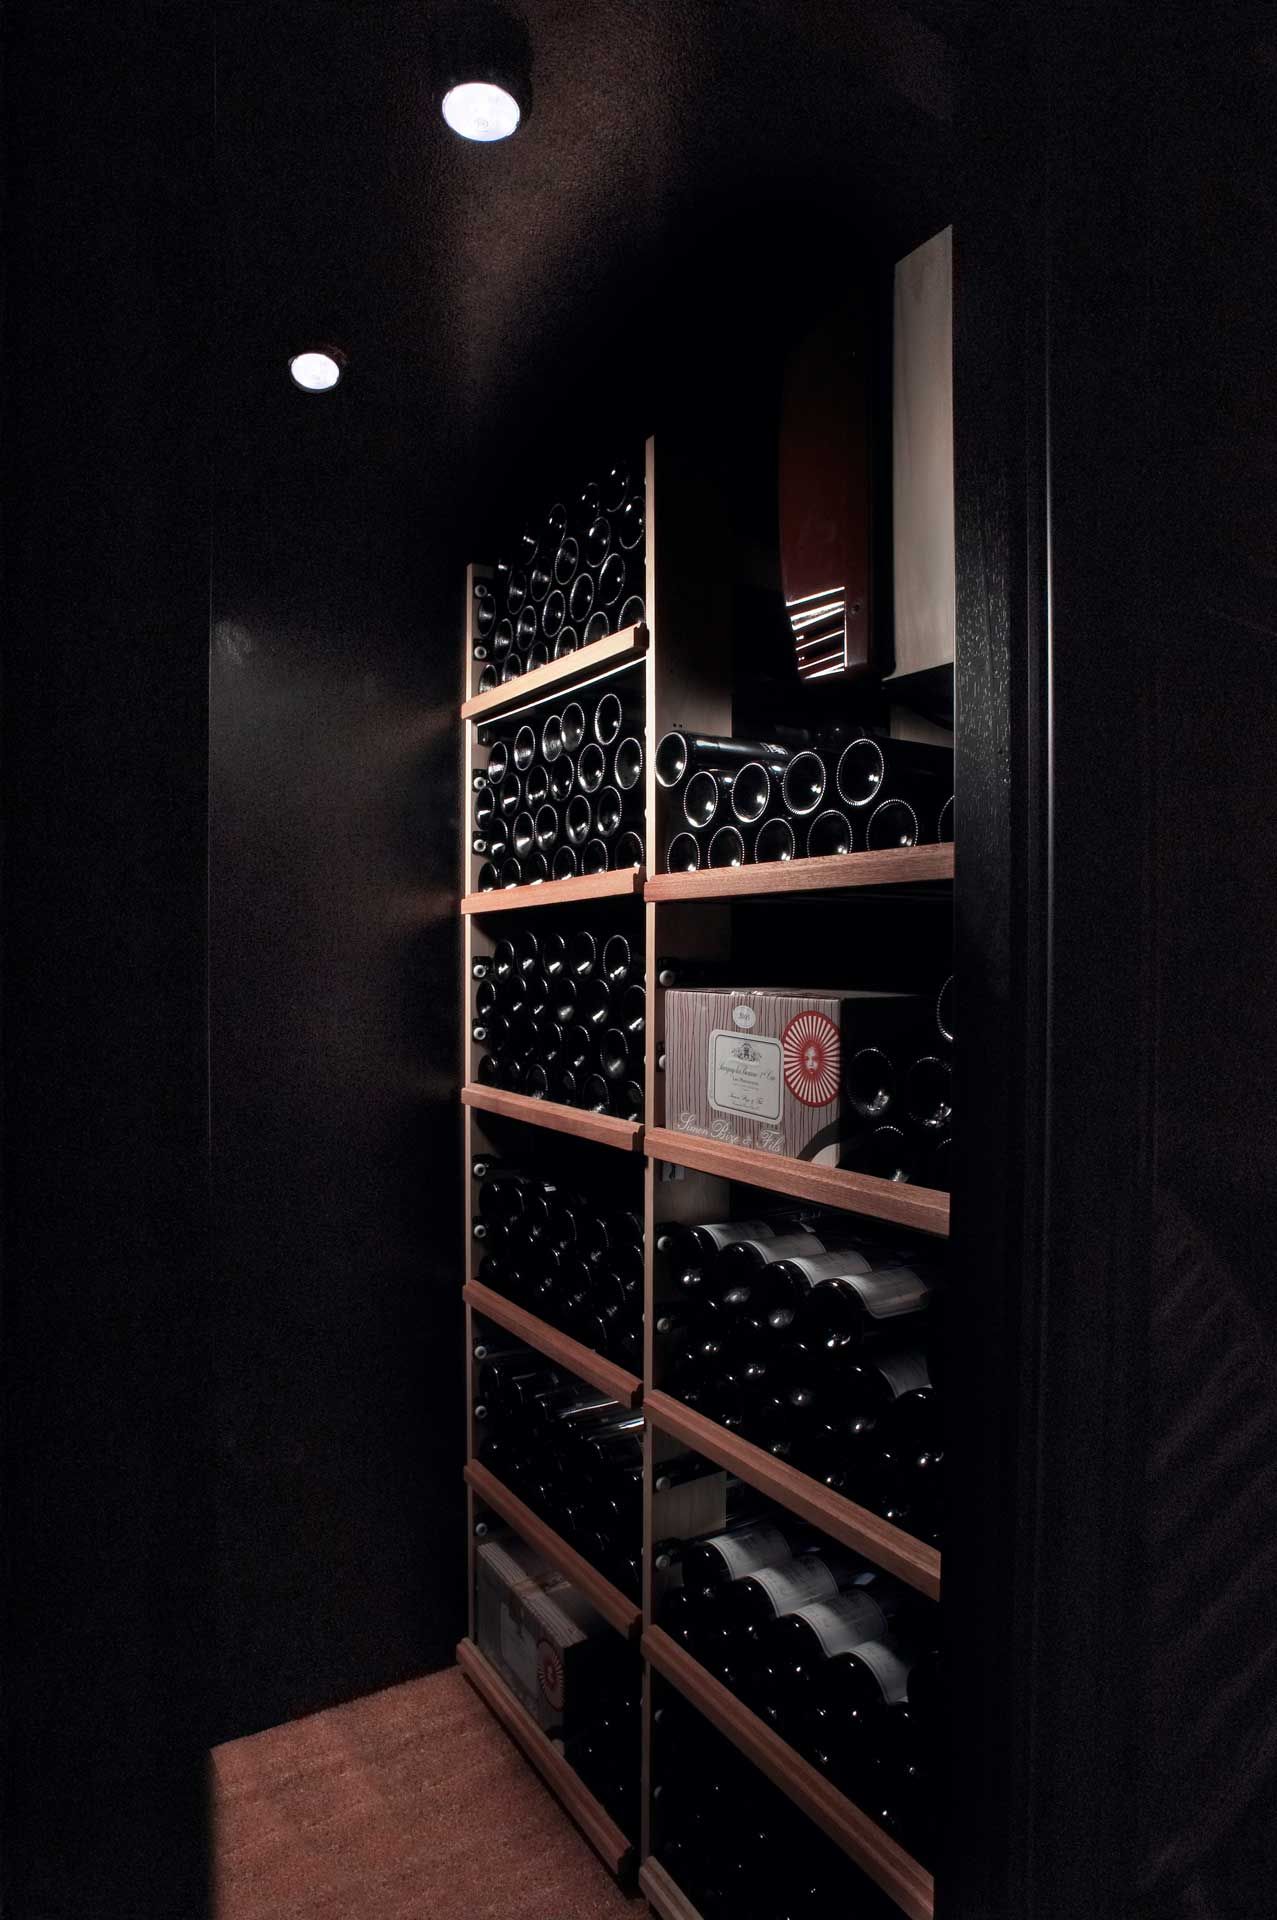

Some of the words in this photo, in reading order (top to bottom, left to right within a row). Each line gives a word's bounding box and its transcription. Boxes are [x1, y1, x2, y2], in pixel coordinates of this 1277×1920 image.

[677, 1112, 709, 1136] Simon
[710, 1119, 739, 1145] Bize
[756, 1128, 785, 1153] Fils
